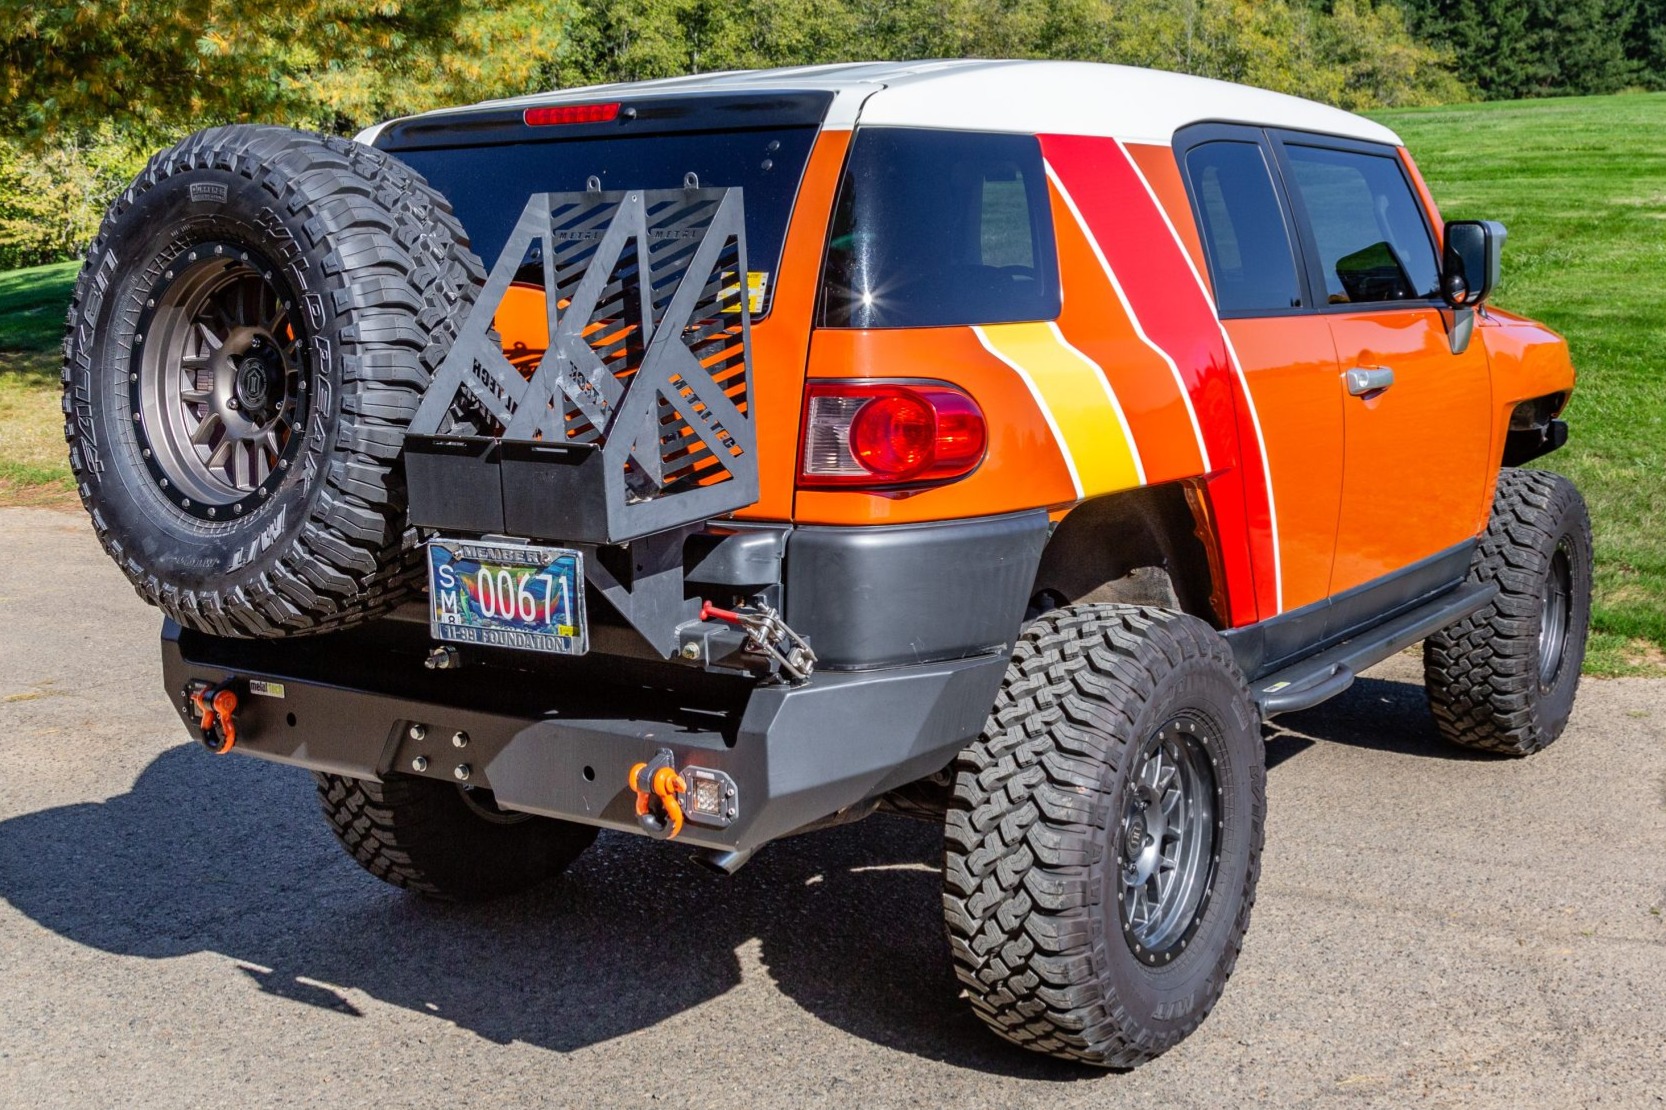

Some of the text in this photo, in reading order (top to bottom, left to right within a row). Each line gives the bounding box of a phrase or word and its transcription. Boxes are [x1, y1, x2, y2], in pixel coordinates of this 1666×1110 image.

[559, 231, 600, 241] METAL
[655, 230, 697, 240] METAL
[254, 206, 332, 498] WILDPEAK
[668, 373, 744, 458] METAL TECH
[463, 546, 540, 563] MEMBER
[478, 568, 572, 626] 00671
[482, 629, 566, 651] FOUNDATION
